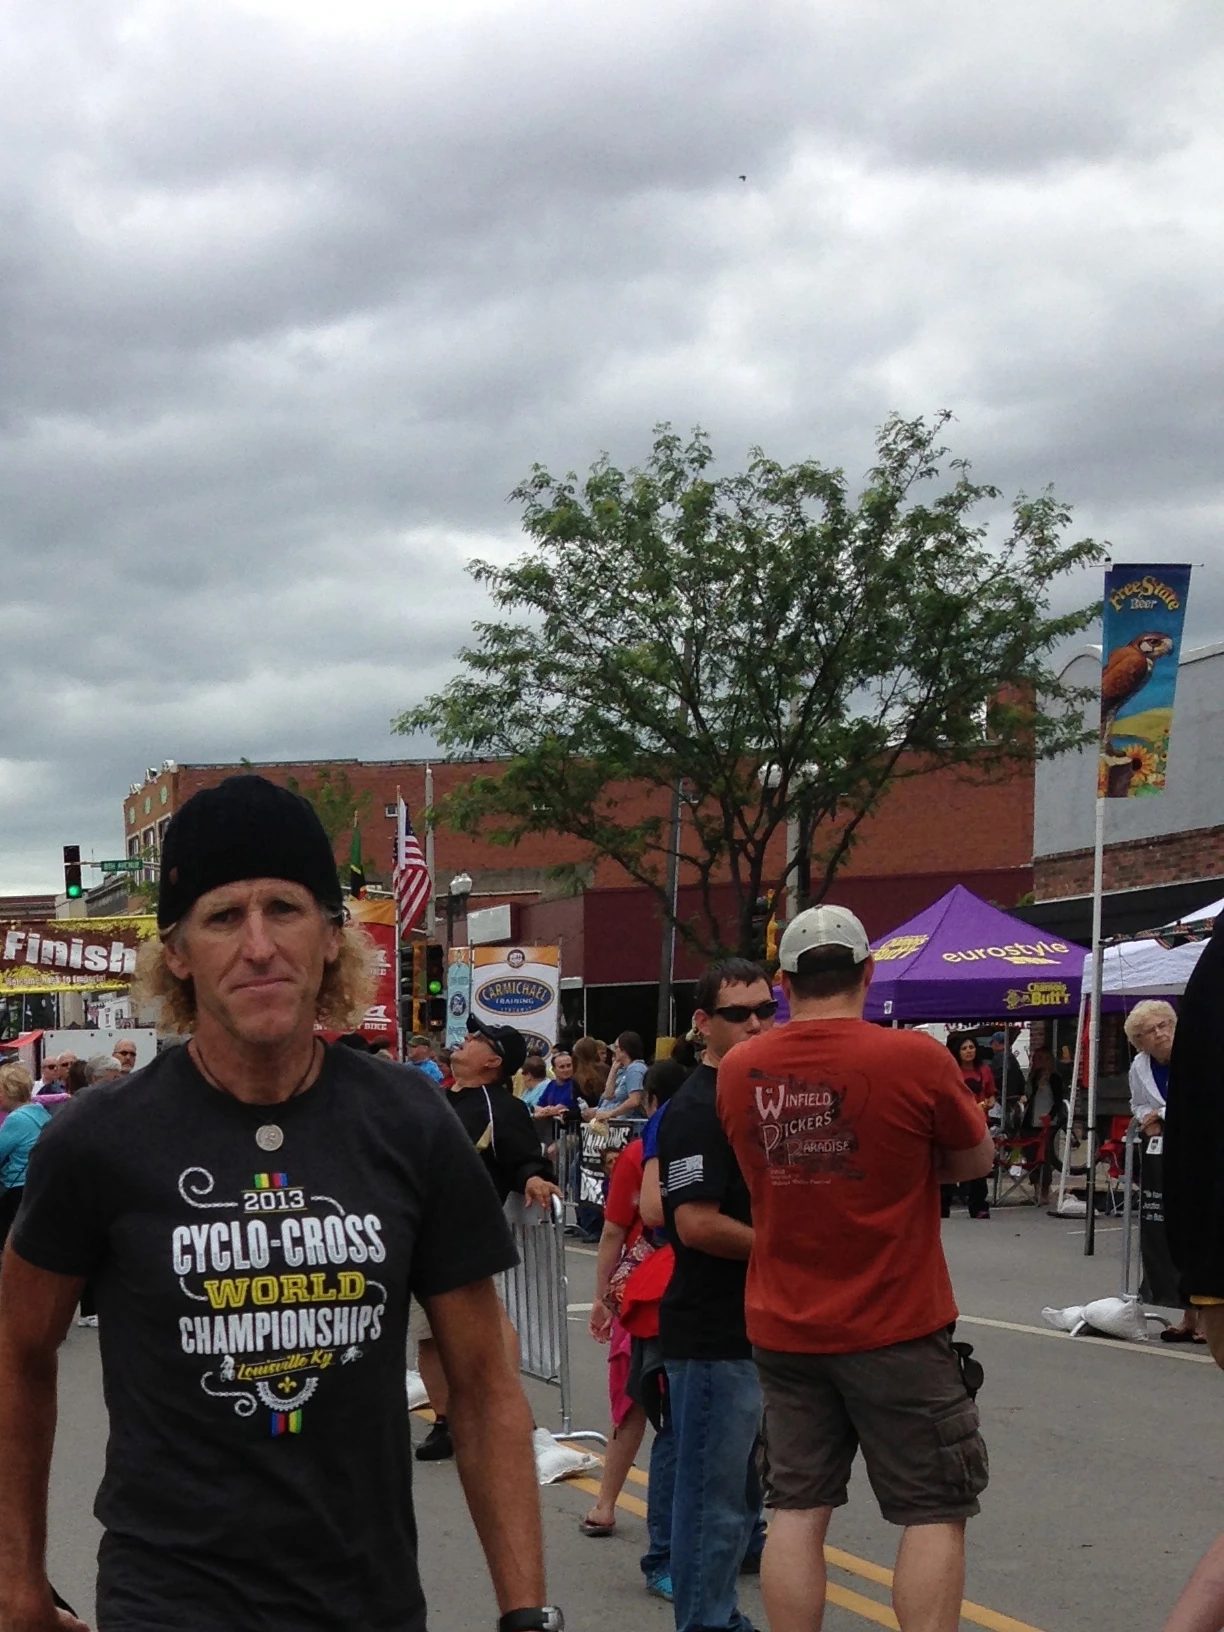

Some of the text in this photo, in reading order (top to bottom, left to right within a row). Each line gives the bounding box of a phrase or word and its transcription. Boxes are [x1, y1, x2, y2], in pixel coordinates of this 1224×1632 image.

[3, 930, 137, 974] Finish
[942, 941, 1071, 963] eurostyle
[482, 979, 548, 1002] CARMICHAEL
[495, 997, 534, 1006] TRAINING
[755, 1085, 834, 1120] WINFIELD
[786, 1140, 851, 1165] PARADISE
[244, 1189, 306, 1211] 2013
[172, 1214, 387, 1276] CYCLO-CROSS
[204, 1271, 366, 1309] WORLD
[178, 1304, 385, 1355] CHAMPIONSHIPS
[237, 1349, 333, 1380] Louisville Ky
